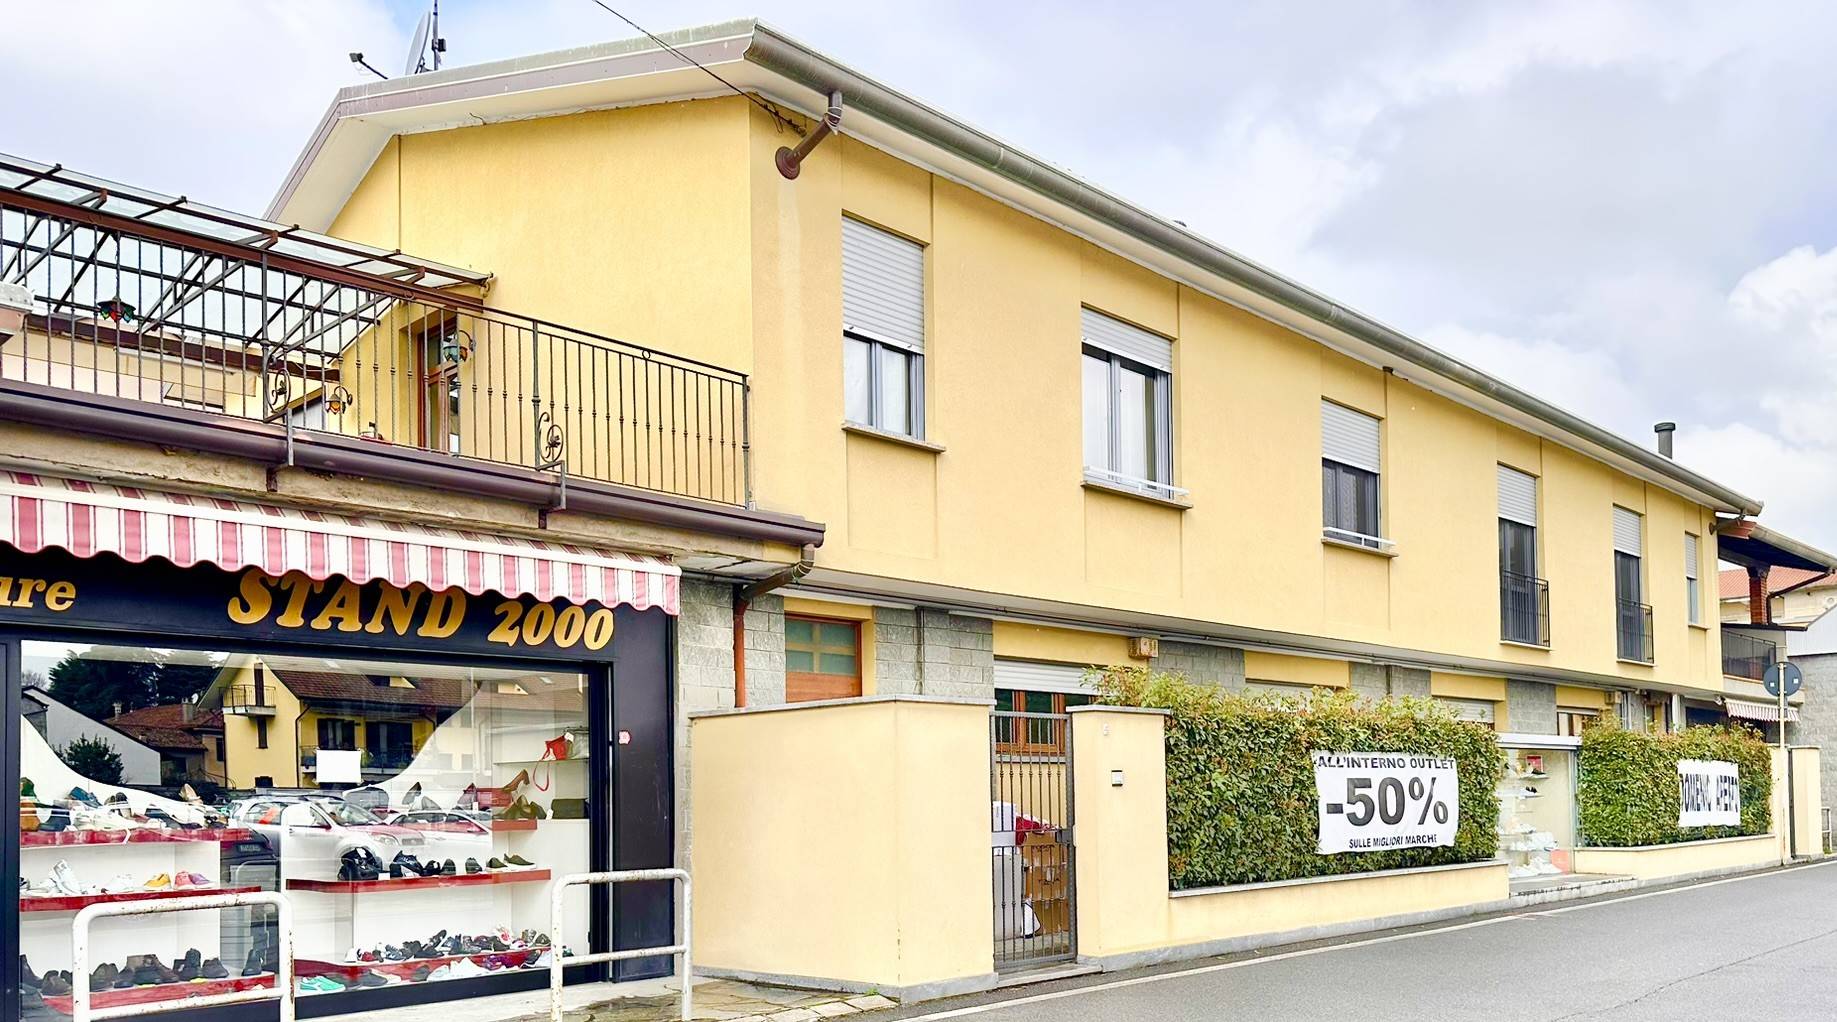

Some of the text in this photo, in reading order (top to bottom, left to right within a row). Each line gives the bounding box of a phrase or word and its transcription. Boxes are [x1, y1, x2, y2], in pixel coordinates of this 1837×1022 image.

[227, 569, 614, 650] STAND 2000
[1318, 756, 1454, 769] ALL'INTERNO OUTLET
[1326, 777, 1449, 826] -50%
[1349, 838, 1371, 849] SULLE
[1373, 836, 1403, 847] MIGLIORI
